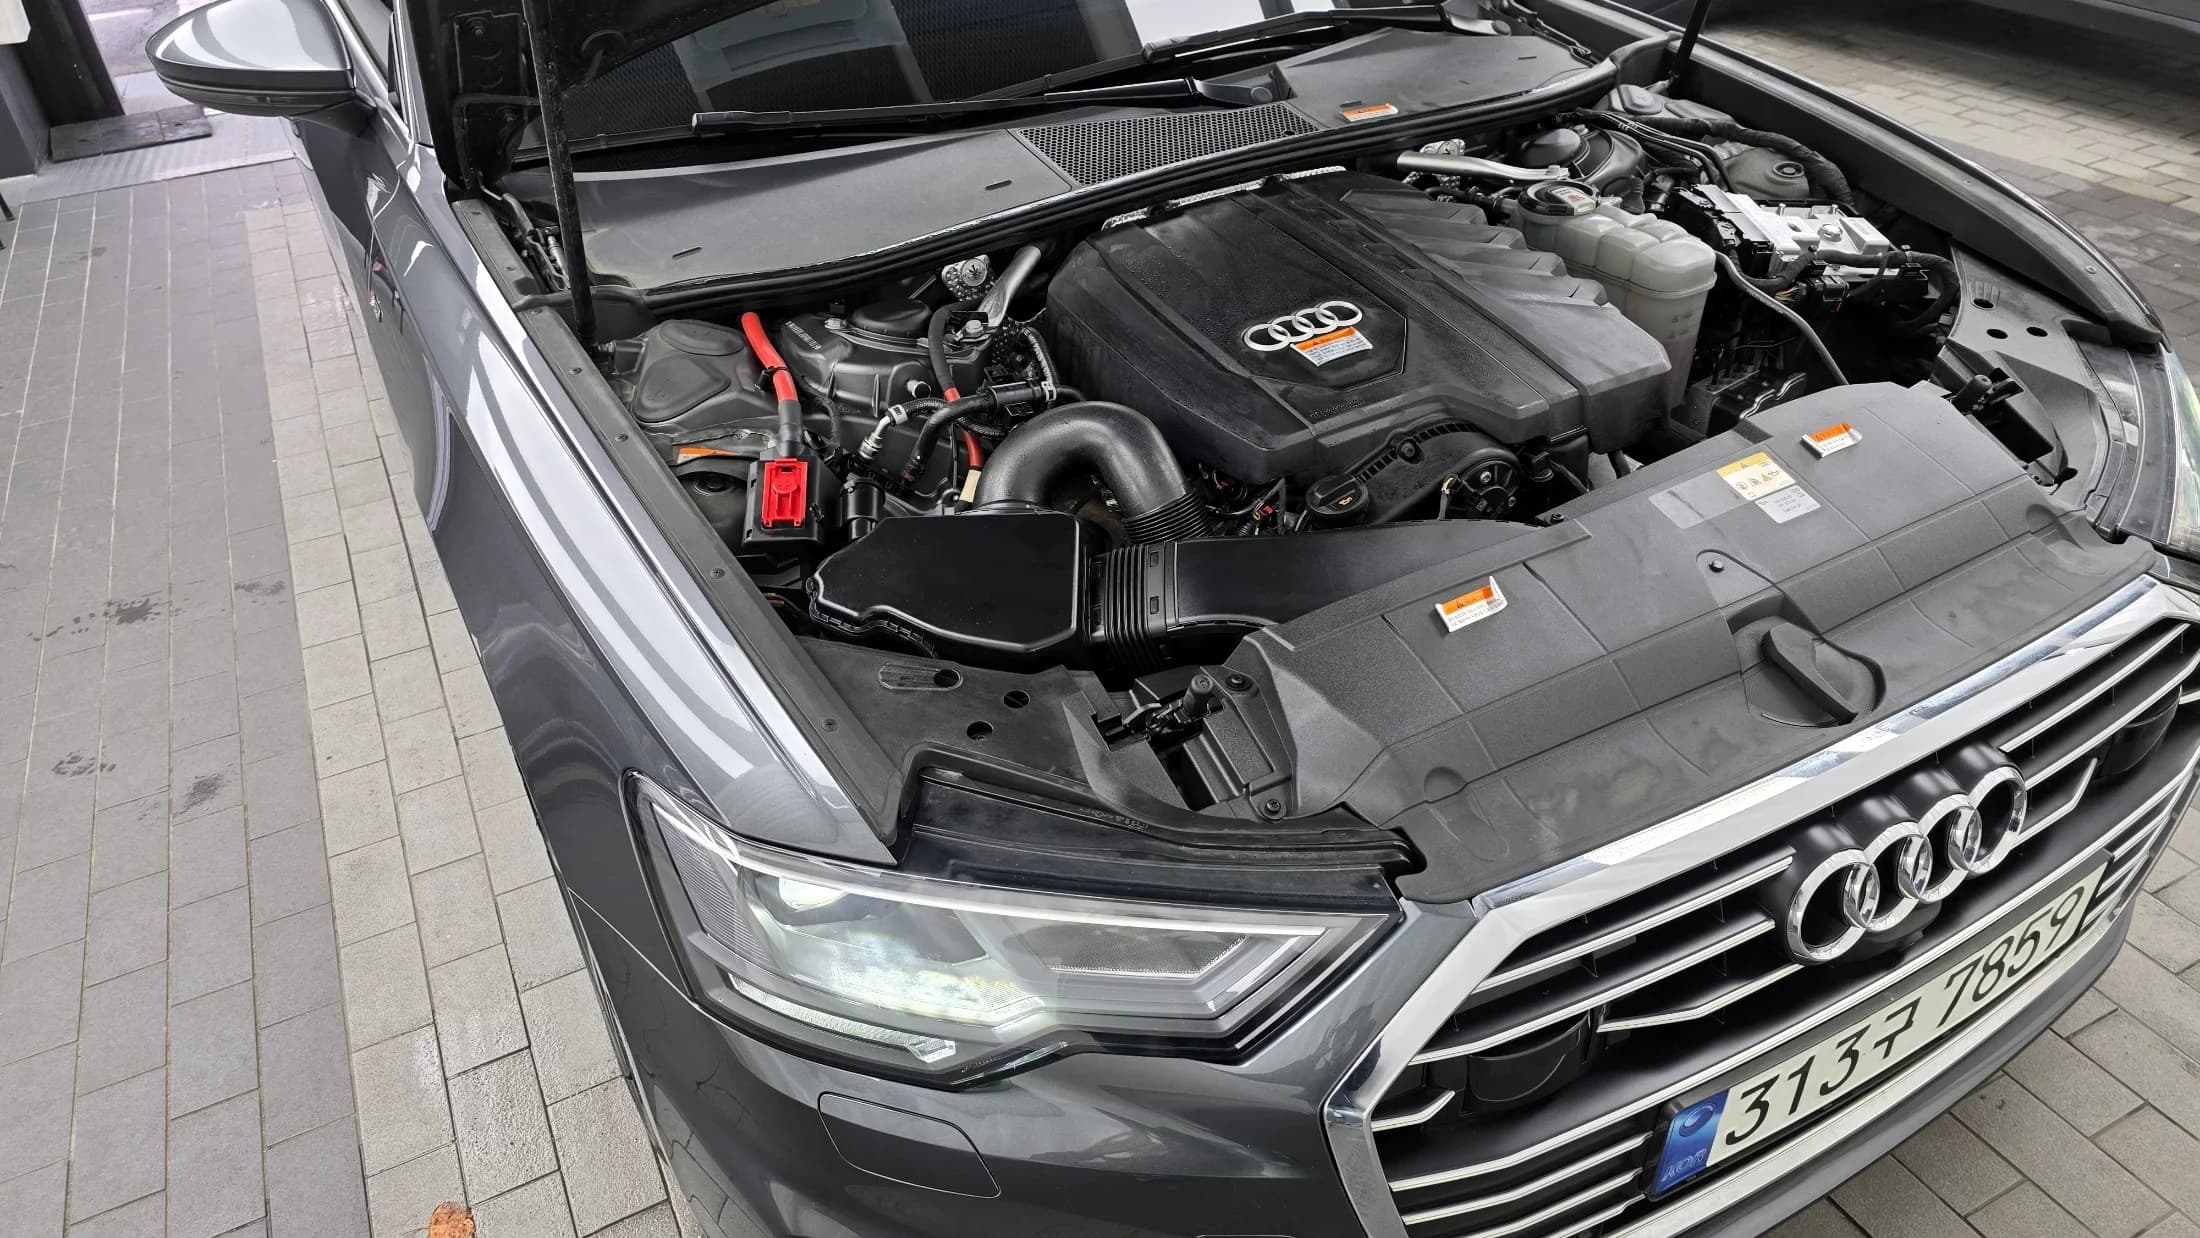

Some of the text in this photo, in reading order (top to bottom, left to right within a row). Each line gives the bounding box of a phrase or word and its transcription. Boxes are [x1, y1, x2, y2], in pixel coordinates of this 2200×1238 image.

[1725, 886, 2085, 1146] 313구 7859
[1661, 1148, 1707, 1182] KOR
